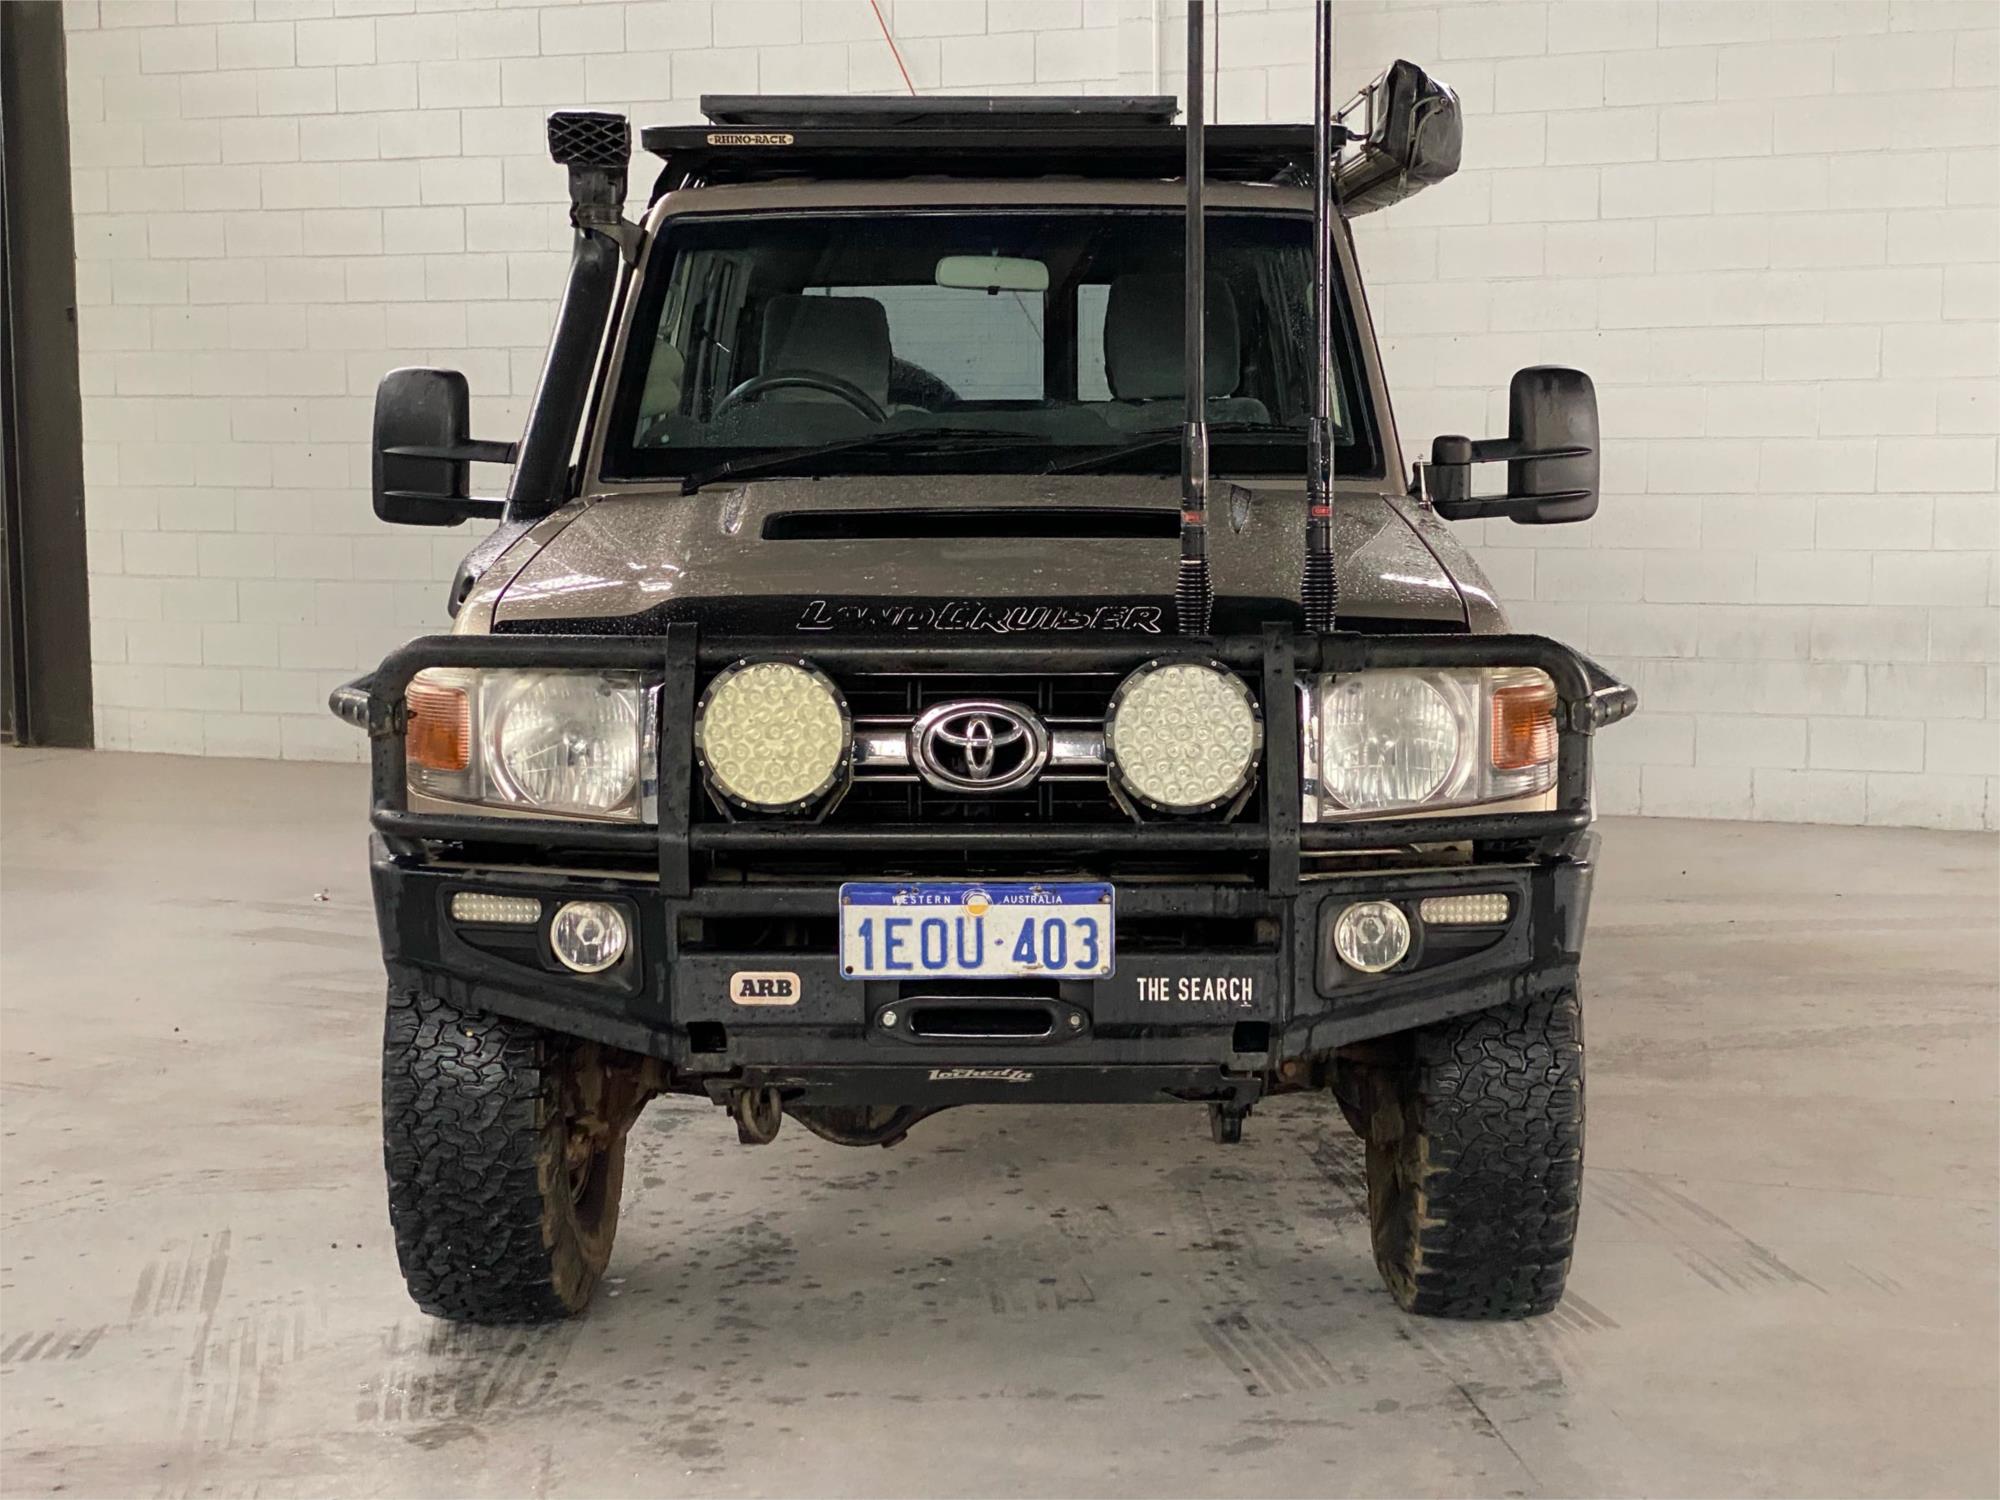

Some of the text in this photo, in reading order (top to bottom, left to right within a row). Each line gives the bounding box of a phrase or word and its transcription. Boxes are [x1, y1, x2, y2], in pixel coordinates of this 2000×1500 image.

[714, 135, 787, 144] RHINO-RACK
[892, 895, 1063, 904] WESTERN AUSTRALIA
[740, 979, 793, 997] ARB
[1136, 977, 1253, 1001] THE SEARCH
